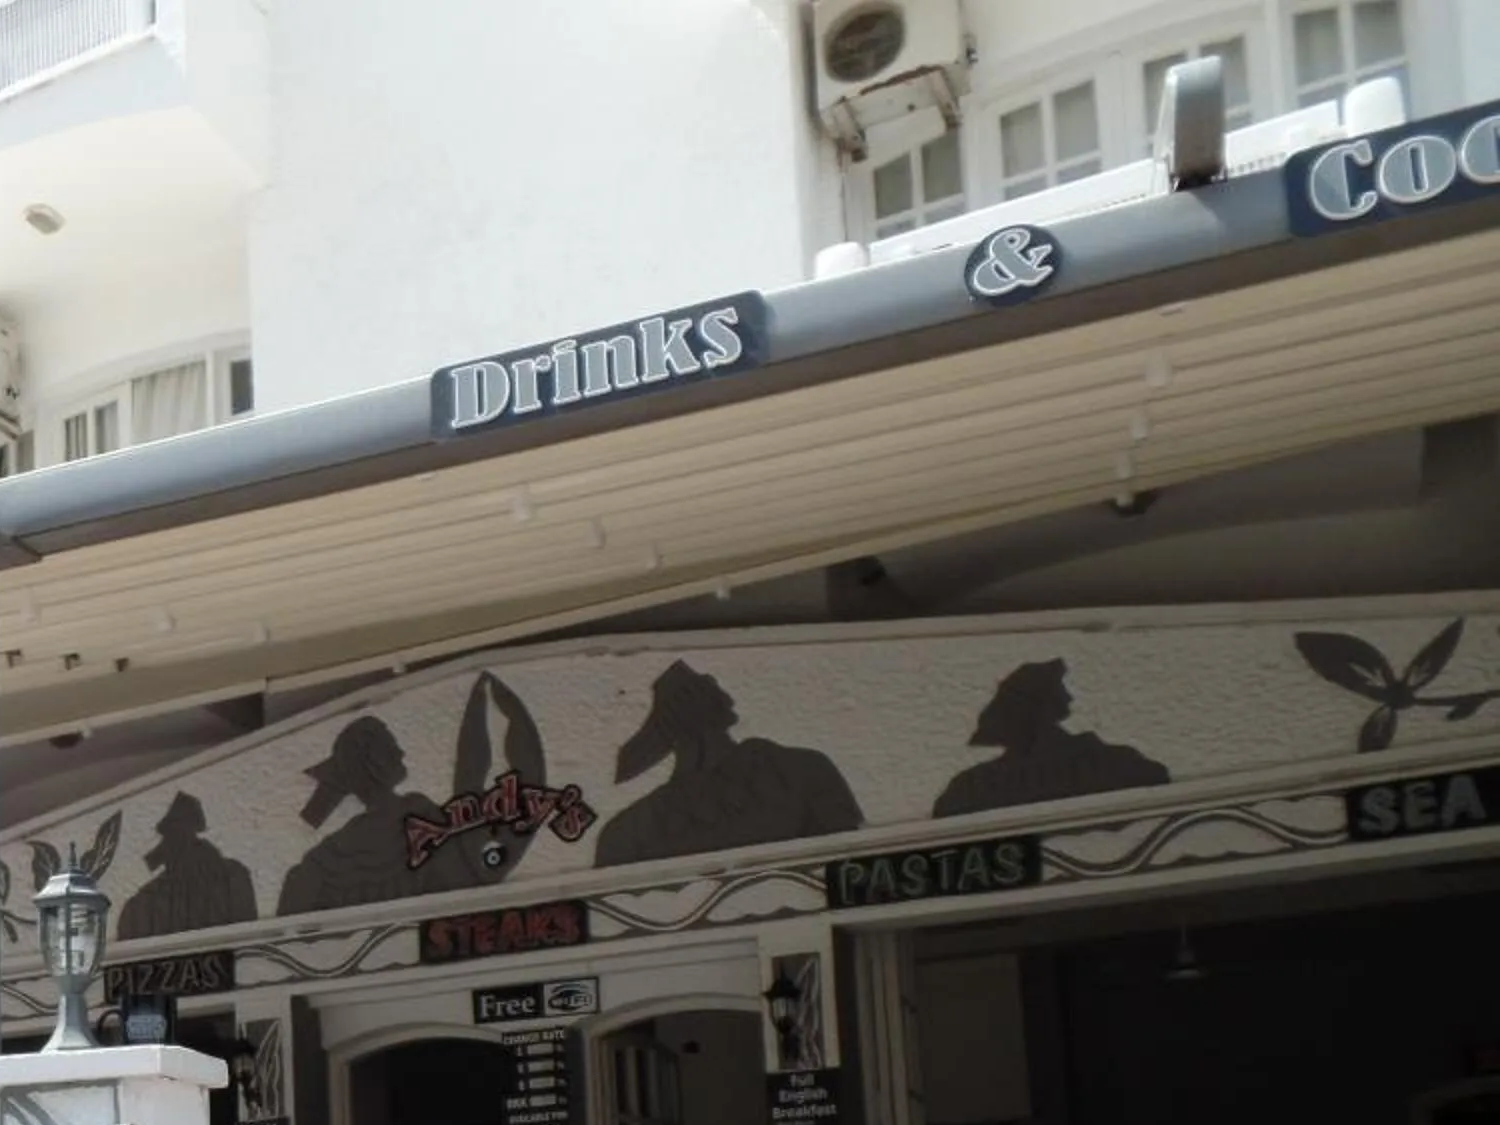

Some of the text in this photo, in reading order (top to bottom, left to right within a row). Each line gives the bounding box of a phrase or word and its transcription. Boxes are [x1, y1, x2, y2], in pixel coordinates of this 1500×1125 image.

[972, 227, 1054, 297] &
[448, 306, 744, 429] Drinks
[404, 772, 594, 868] Andy's
[1358, 774, 1488, 835] SEA
[838, 840, 1025, 903] PASTAS
[426, 904, 580, 960] STEAKS
[107, 955, 223, 1000] PIZZAS
[480, 993, 537, 1019] Free
